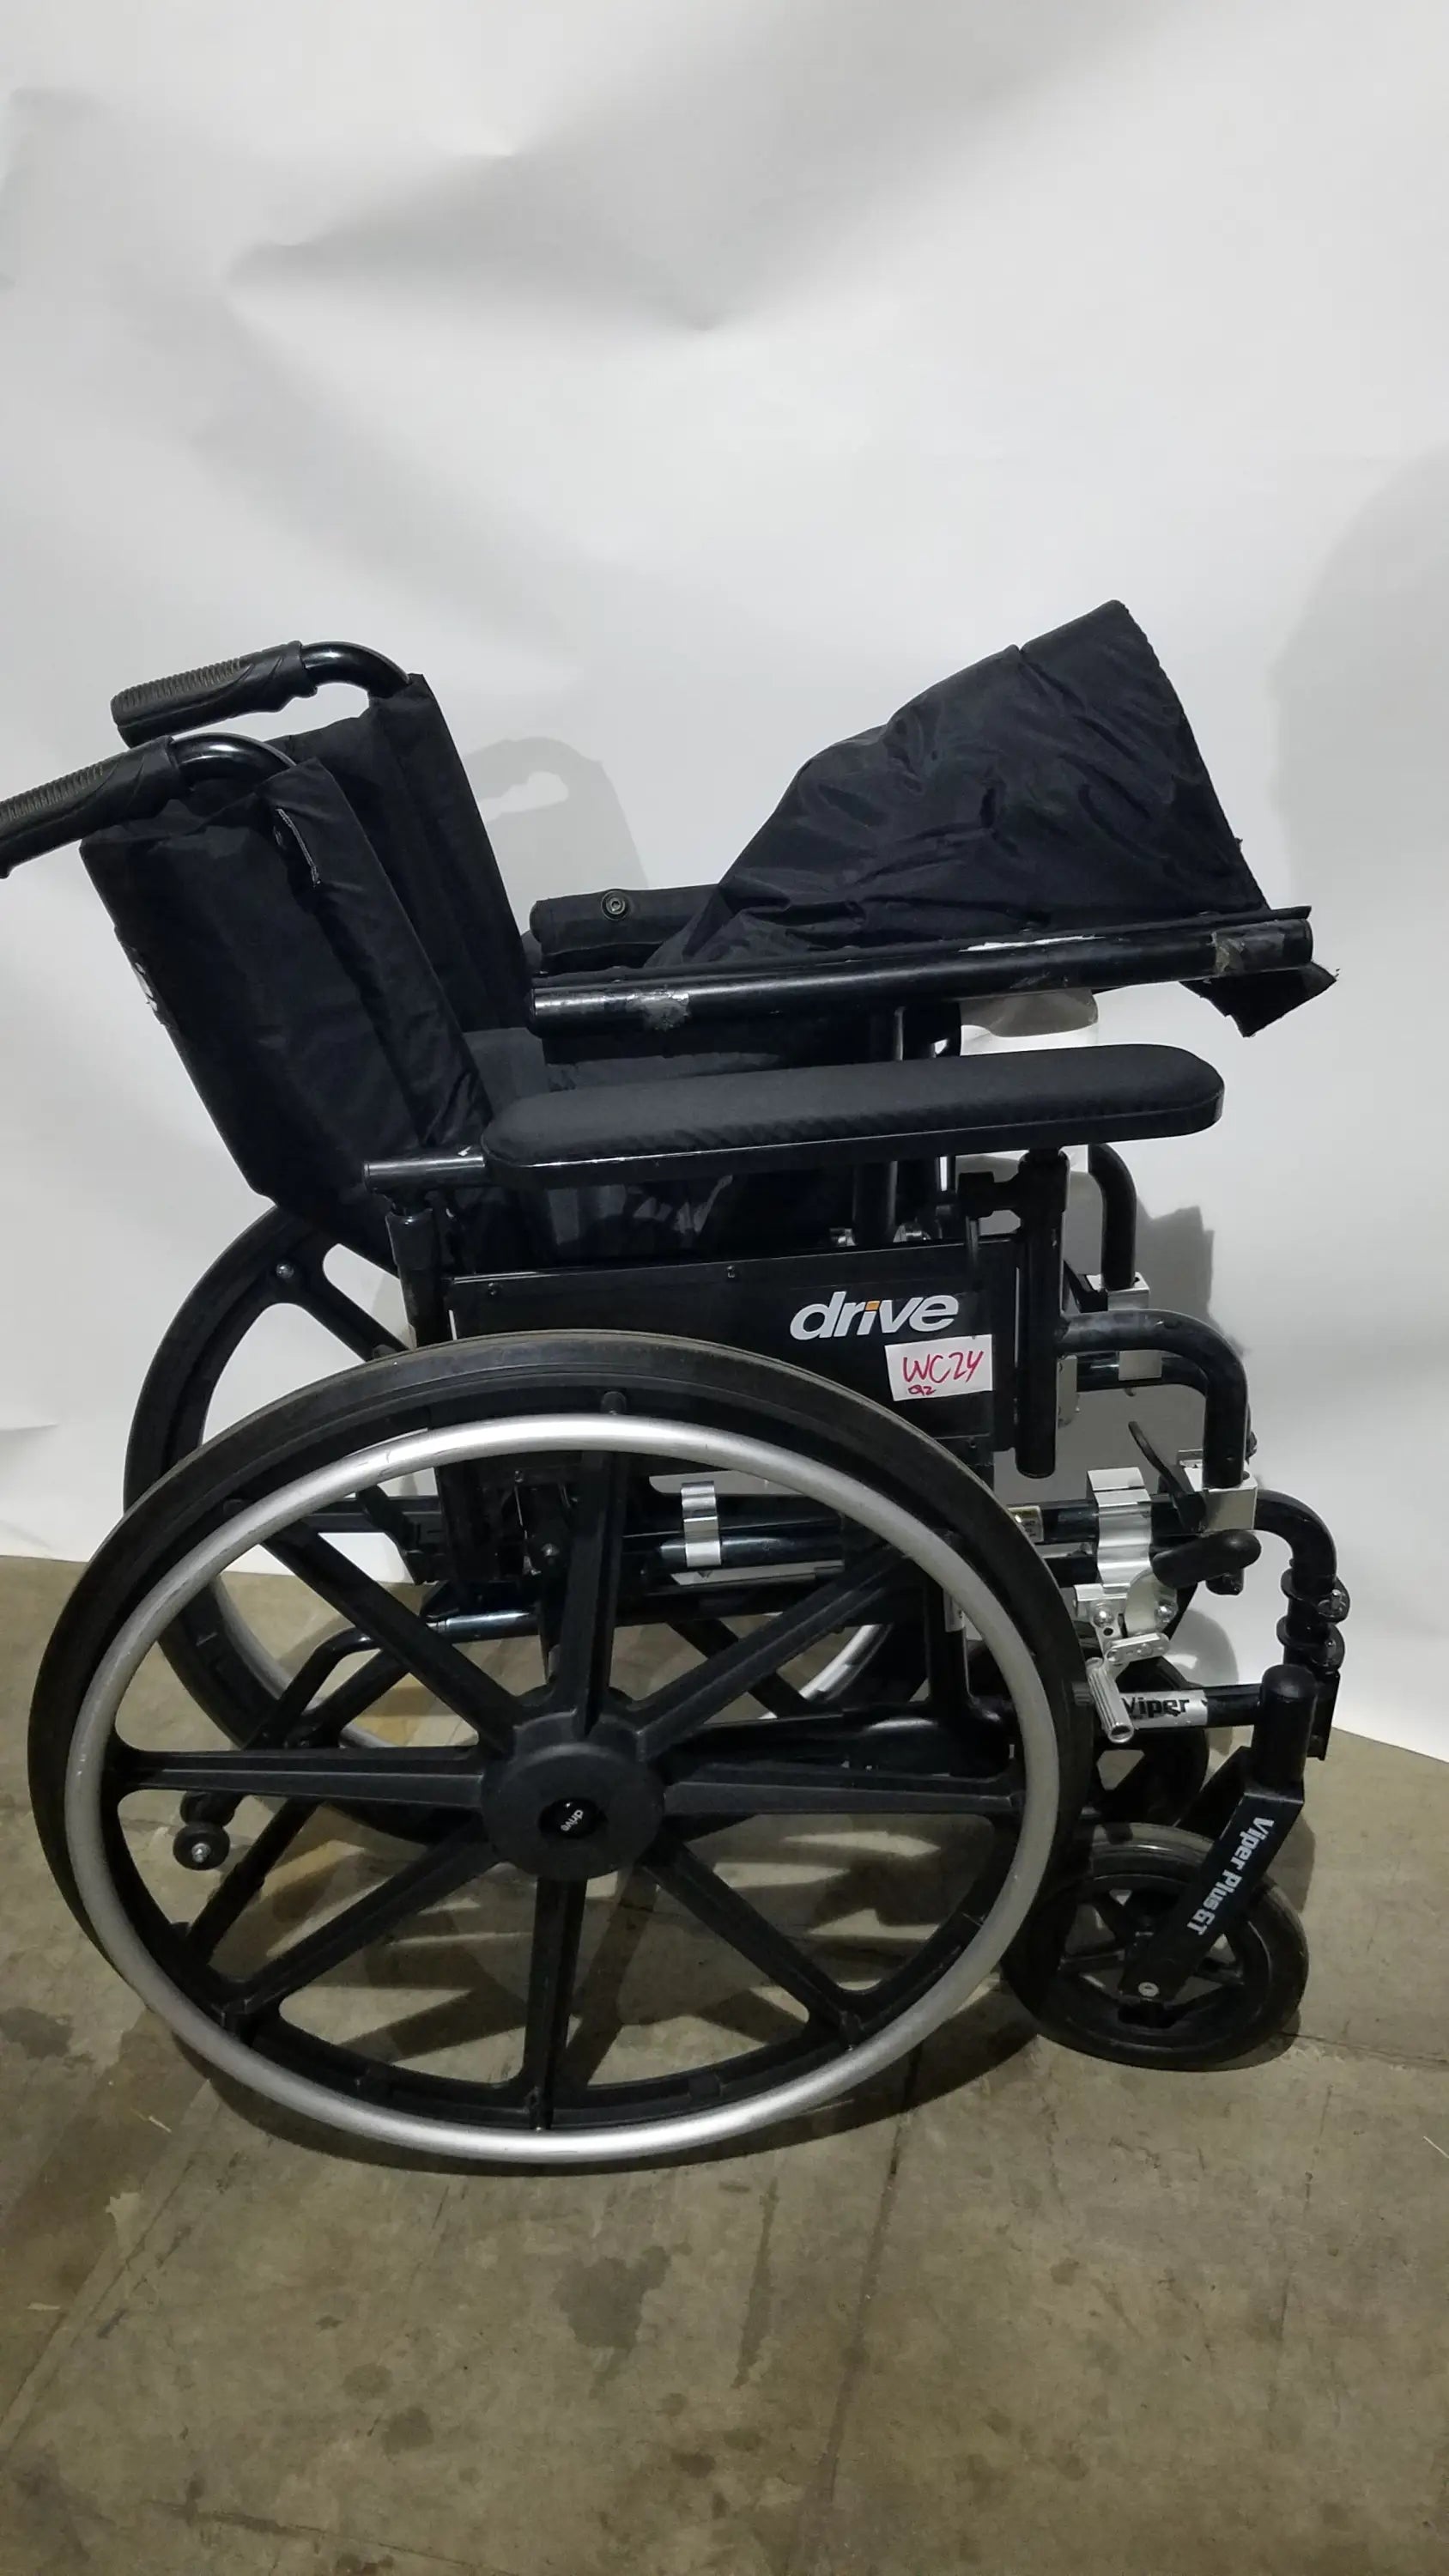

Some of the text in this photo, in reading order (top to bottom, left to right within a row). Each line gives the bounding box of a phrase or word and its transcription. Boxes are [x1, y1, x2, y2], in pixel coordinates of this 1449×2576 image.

[790, 1291, 959, 1340] drive
[1121, 1696, 1190, 1718] Viper
[1186, 1817, 1275, 1935] Viper Plus GT
